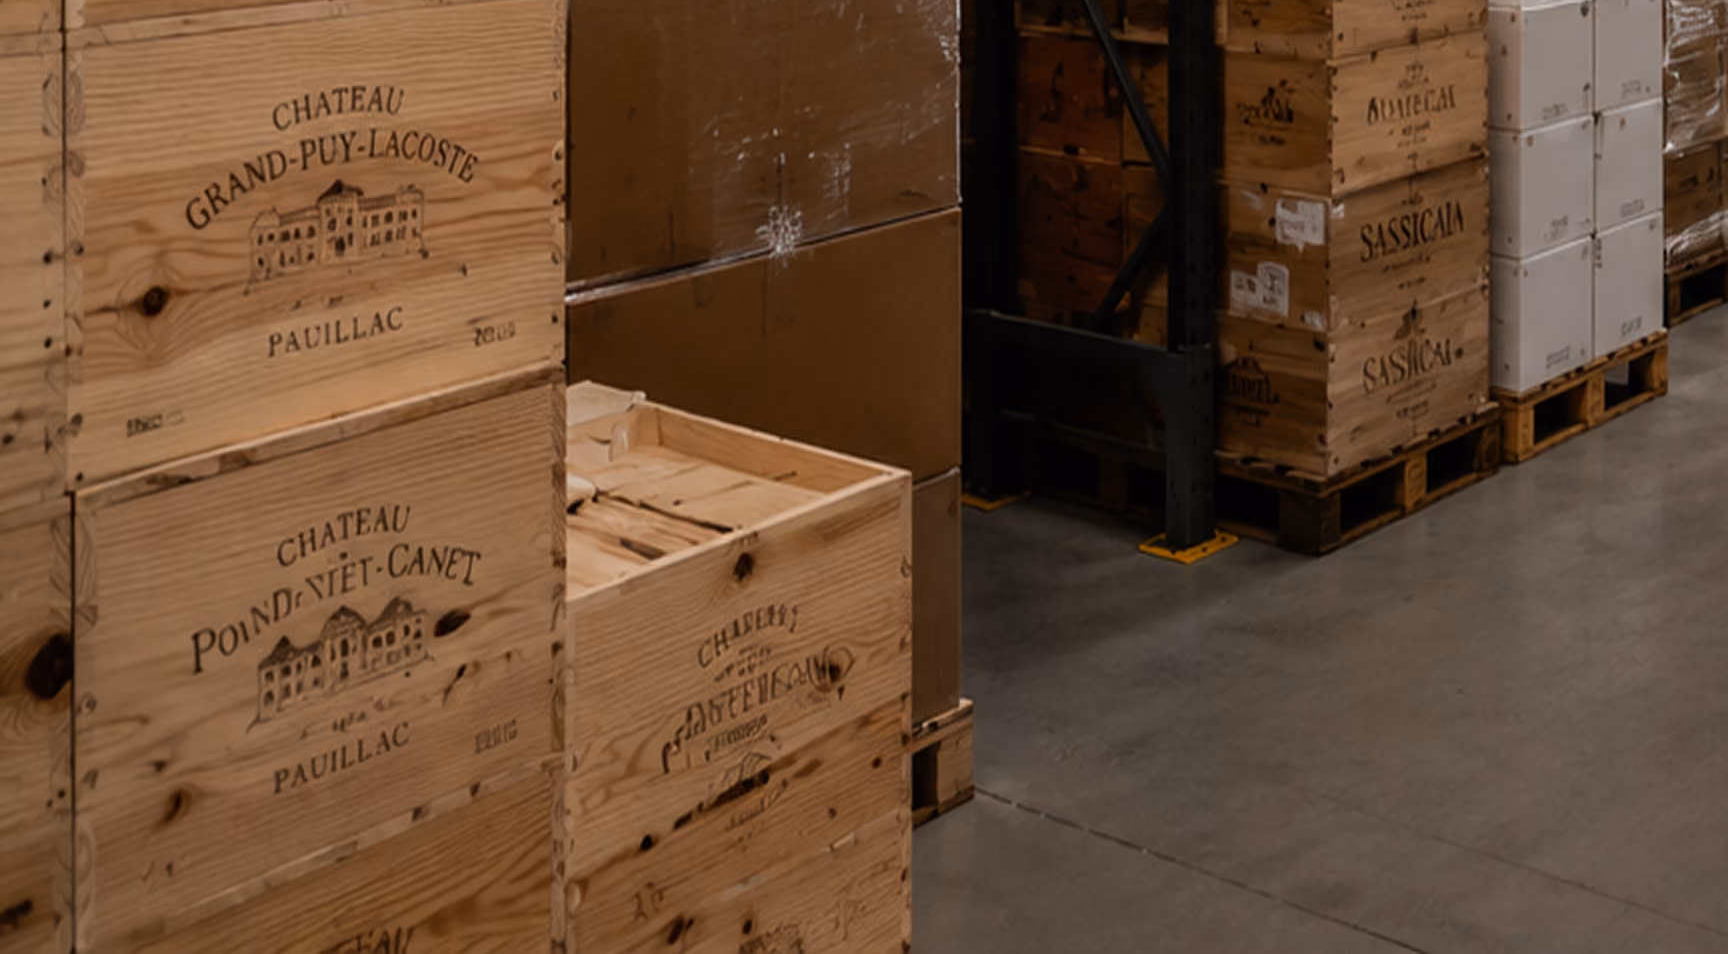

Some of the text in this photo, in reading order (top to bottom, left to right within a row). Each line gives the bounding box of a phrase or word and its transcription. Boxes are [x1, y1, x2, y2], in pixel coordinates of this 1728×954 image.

[272, 85, 404, 131] CHATEAU
[185, 128, 478, 231] GRAND-PUY-LACOSTE
[268, 306, 404, 358] PAUILLAC
[276, 505, 410, 567] CHATEAU
[273, 722, 409, 794] PAUILLAC
